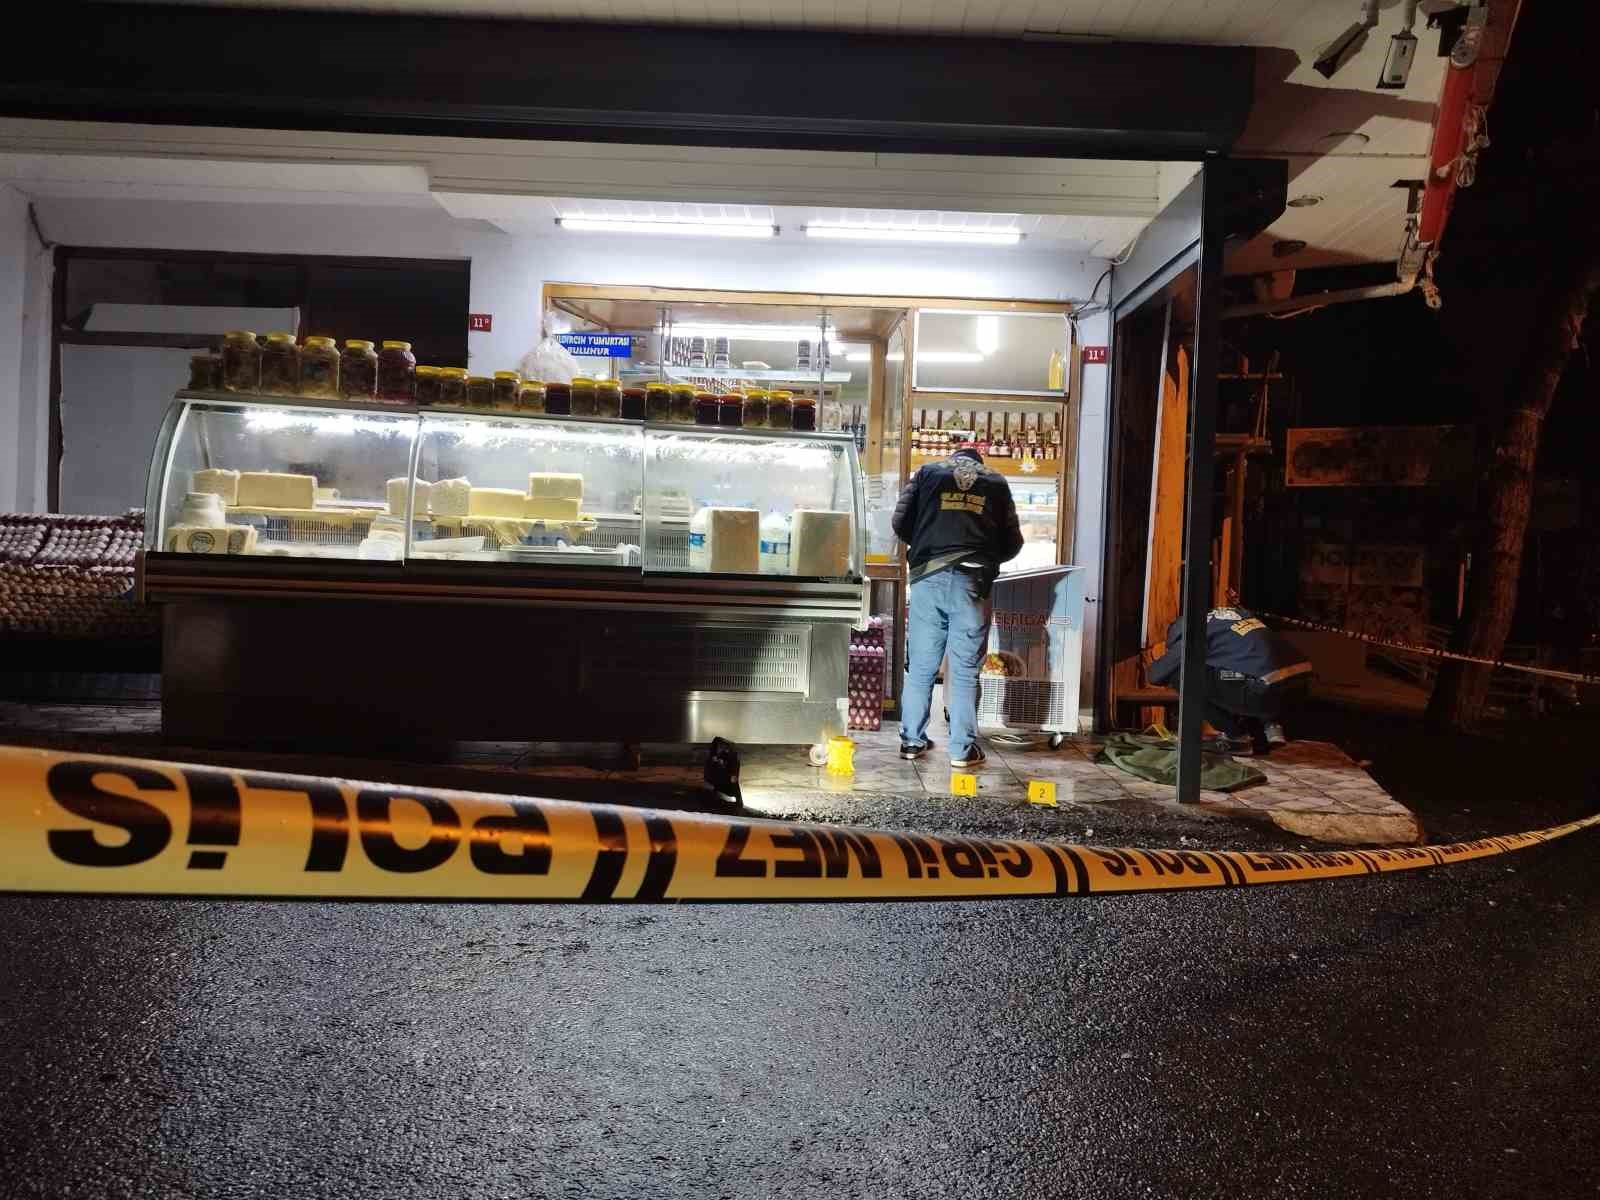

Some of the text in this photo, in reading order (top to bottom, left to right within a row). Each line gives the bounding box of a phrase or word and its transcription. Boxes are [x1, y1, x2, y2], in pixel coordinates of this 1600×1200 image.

[555, 335, 587, 345] ILDIRCIN
[588, 336, 630, 346] YUMURTASI
[47, 760, 553, 875] POLİS
